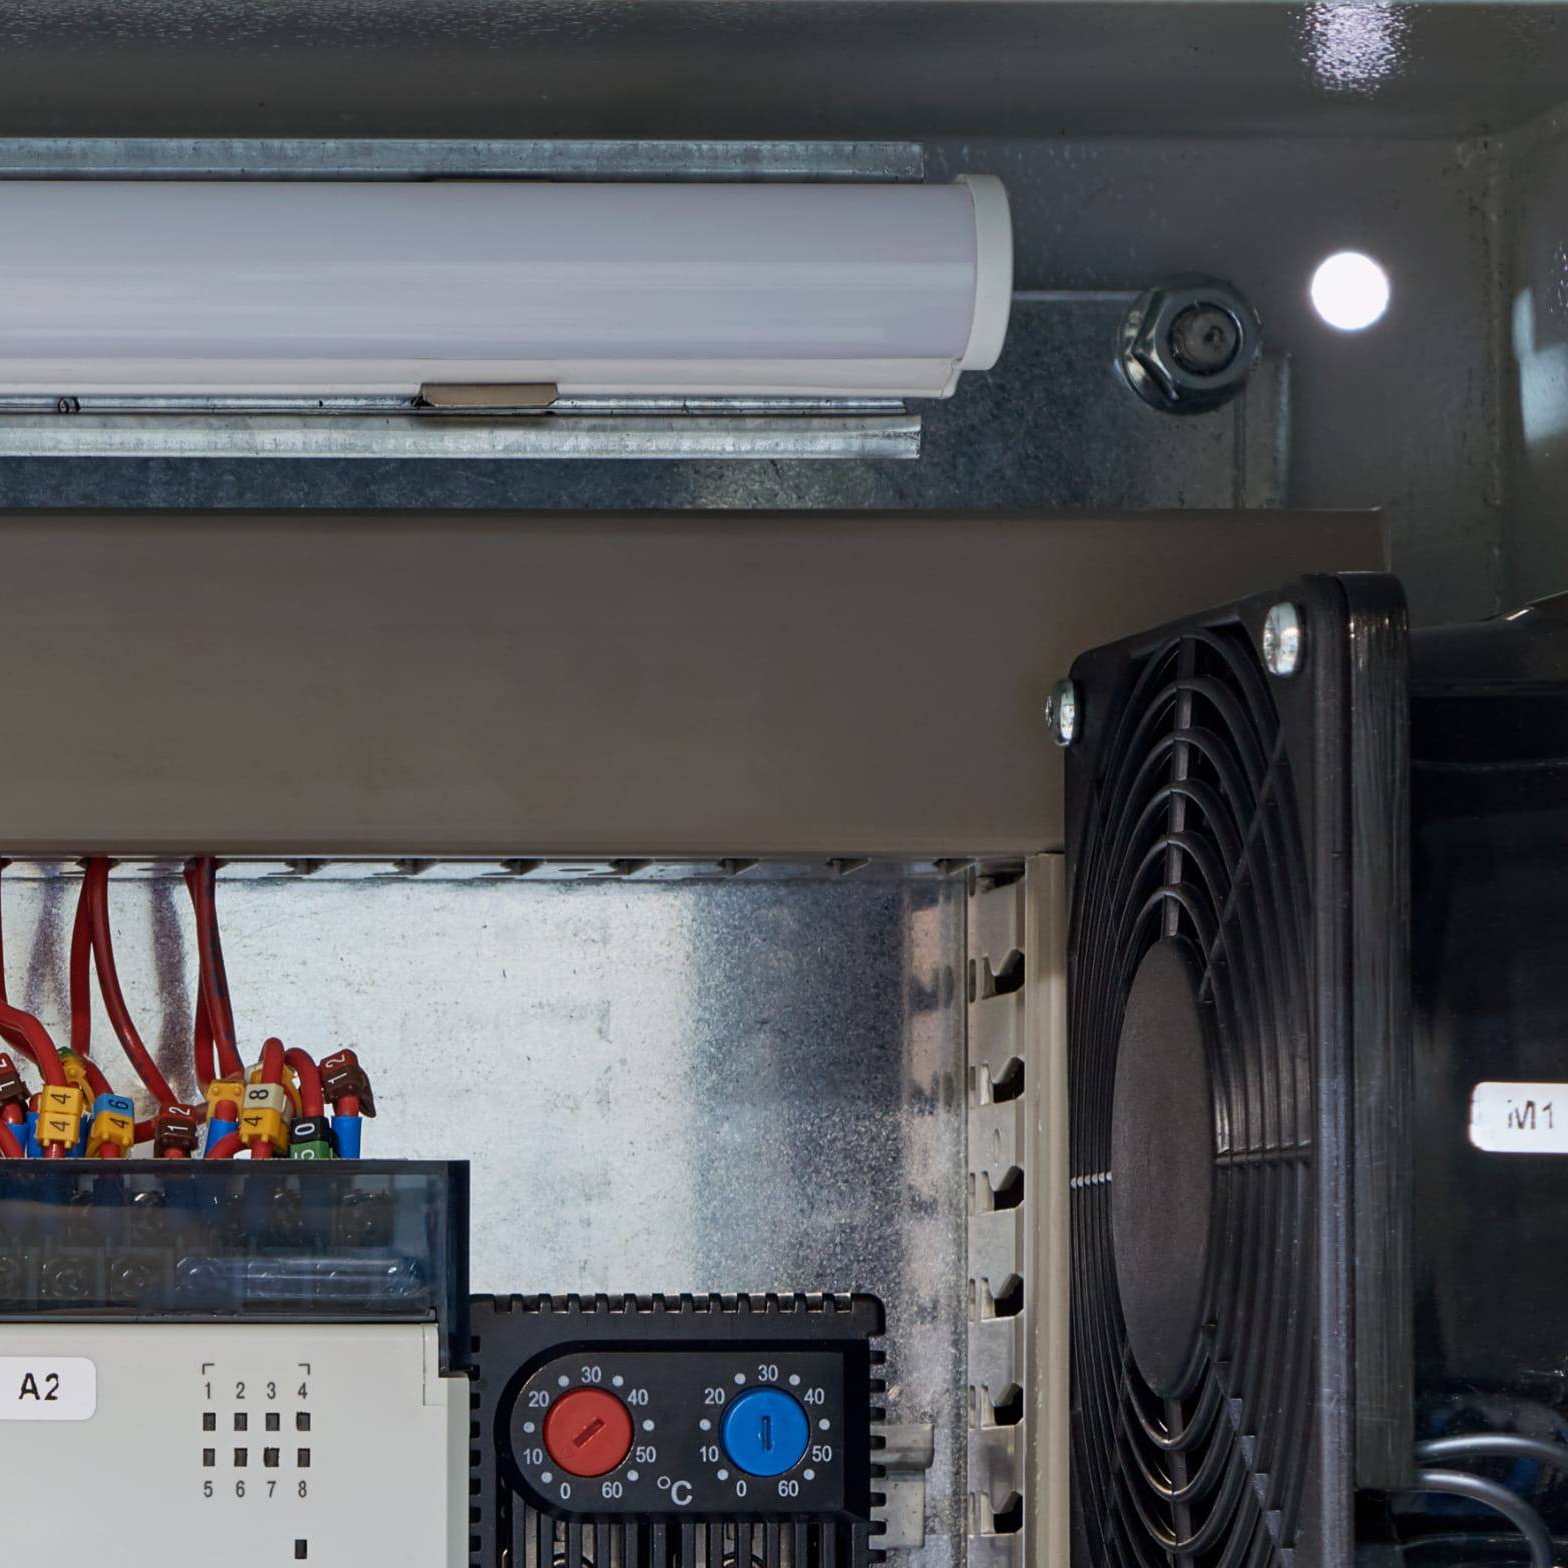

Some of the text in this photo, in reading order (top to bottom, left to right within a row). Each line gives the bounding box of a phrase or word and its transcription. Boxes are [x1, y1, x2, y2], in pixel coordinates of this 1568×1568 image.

[581, 1366, 602, 1383] 30
[758, 1365, 778, 1382] 30
[18, 1372, 60, 1401] A2
[528, 1391, 549, 1408] 20
[627, 1389, 648, 1406] 40
[704, 1388, 725, 1405] 20
[804, 1388, 825, 1405] 40
[523, 1448, 543, 1465] 10
[636, 1446, 657, 1463] 50
[700, 1446, 719, 1463] 10
[812, 1446, 833, 1462] 50
[602, 1481, 623, 1499] 60
[778, 1480, 799, 1497] 60
